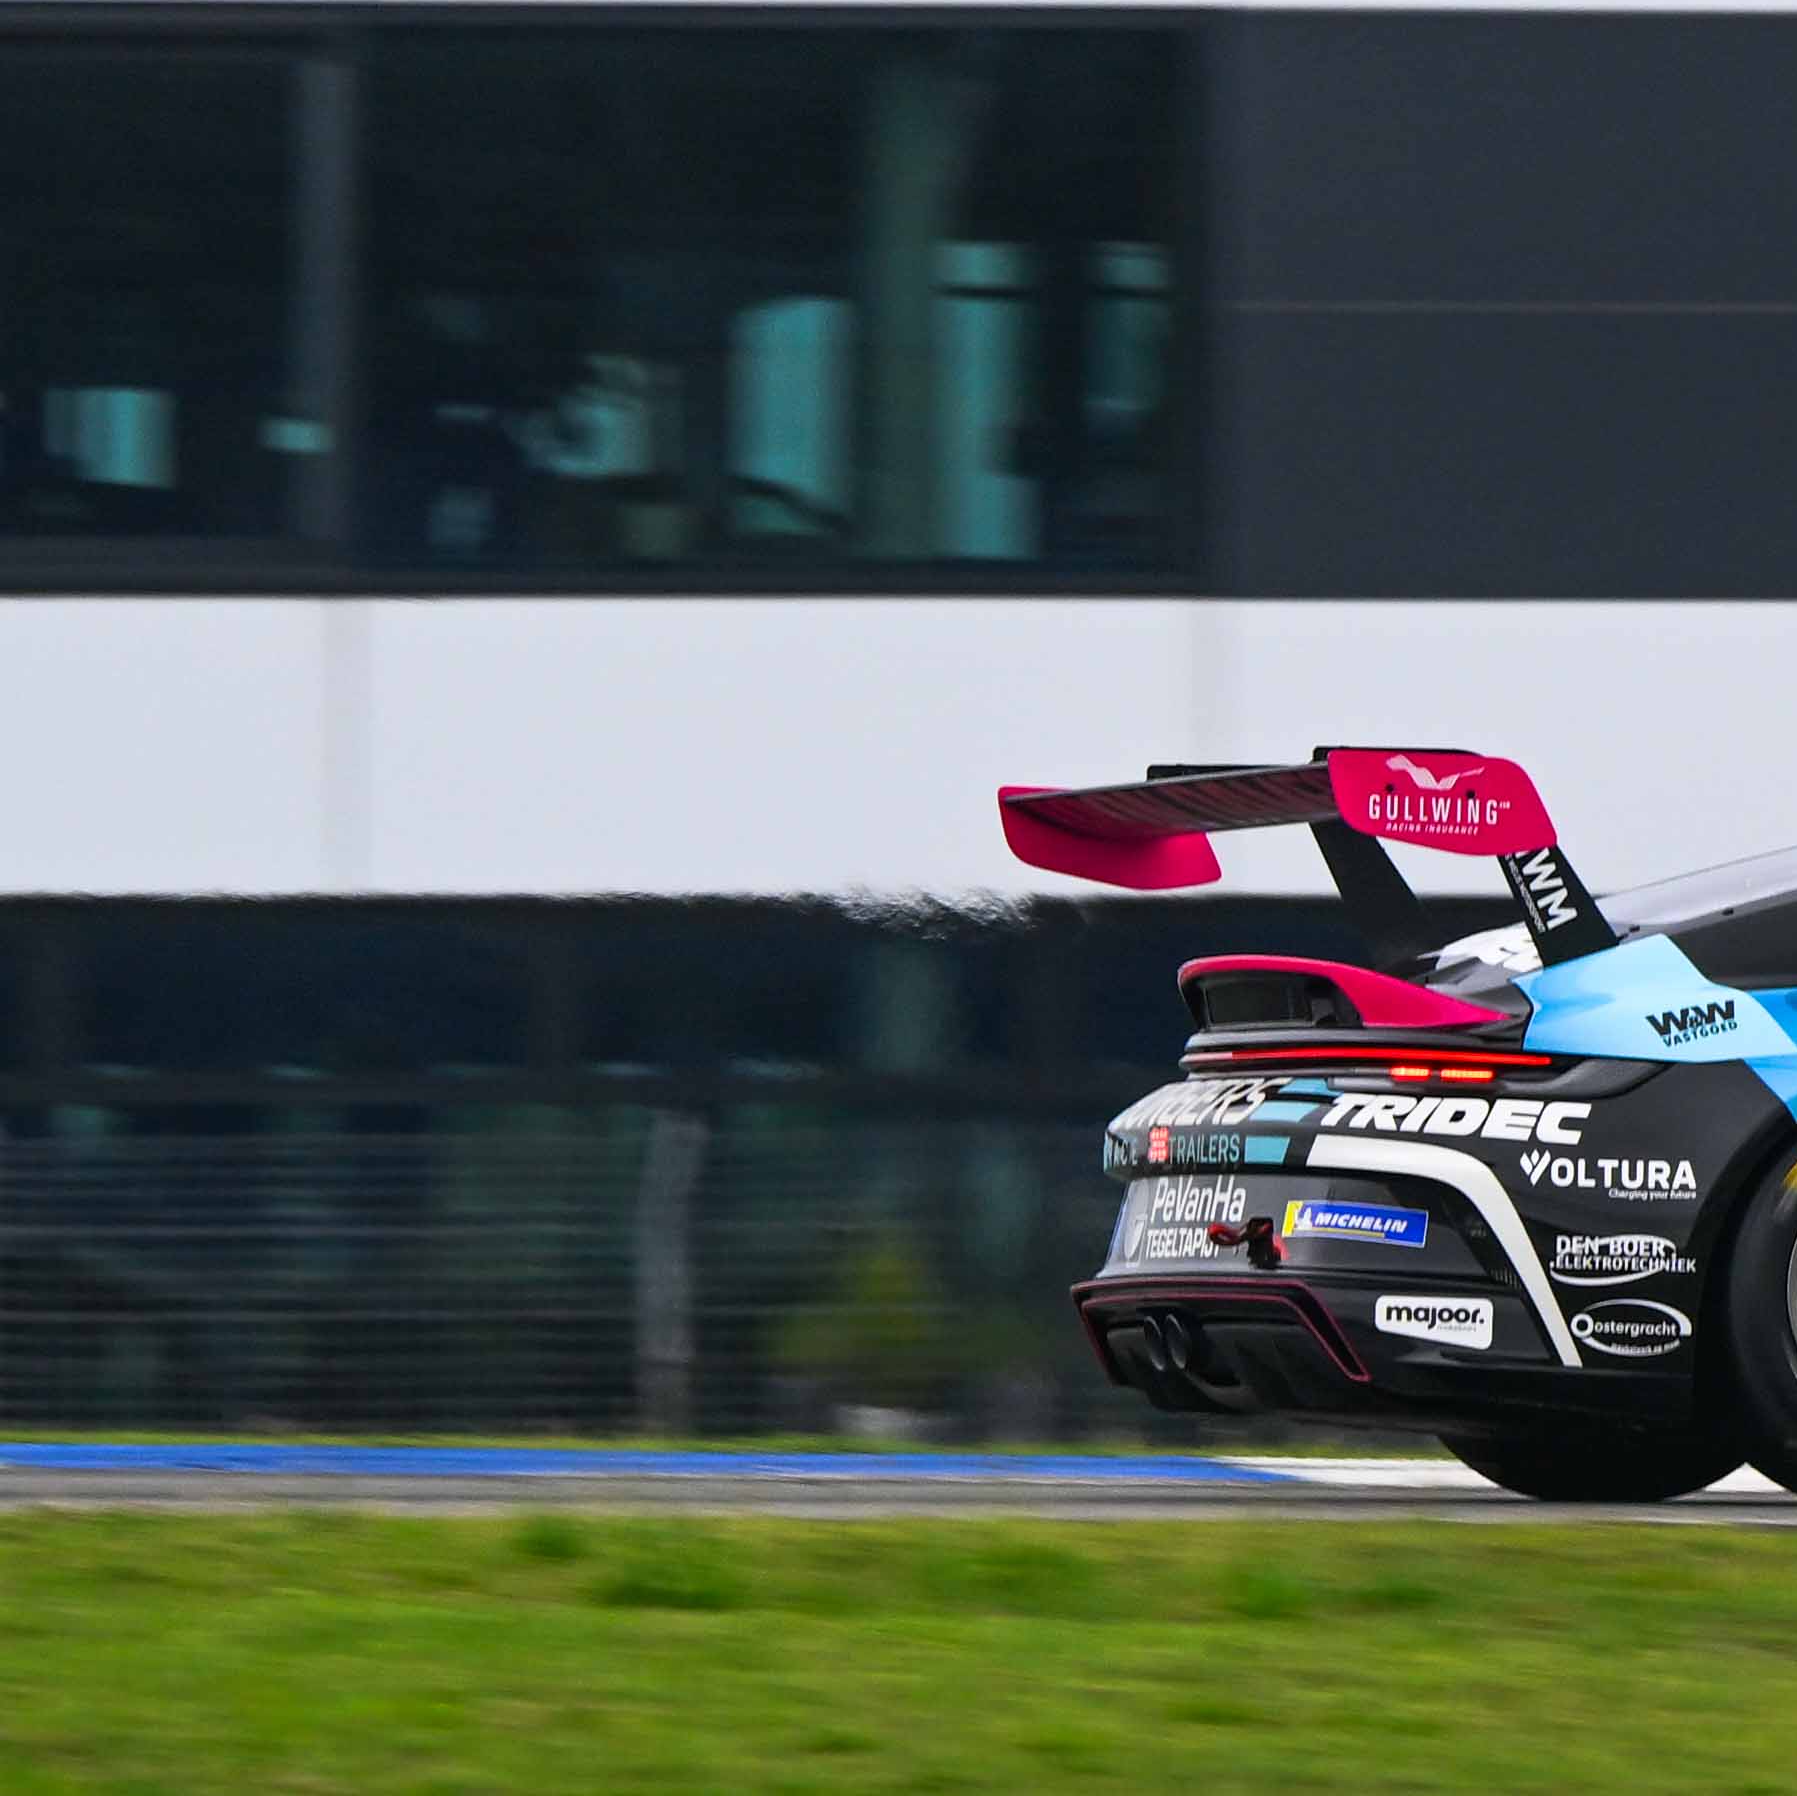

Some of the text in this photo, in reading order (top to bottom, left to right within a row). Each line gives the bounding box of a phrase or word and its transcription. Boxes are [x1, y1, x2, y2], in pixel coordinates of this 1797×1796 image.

[1368, 792, 1498, 825] GULLWING
[1515, 847, 1578, 931] WM
[1320, 1093, 1592, 1144] TRIDEC
[1168, 1134, 1240, 1165] TRAILERS
[1519, 1148, 1697, 1190] VOLTURA
[1151, 1175, 1246, 1223] PeVanHa
[1315, 1211, 1408, 1234] MICHELIN
[1556, 1235, 1666, 1257] DEN BOER
[1571, 1313, 1678, 1339] Oostergracht
